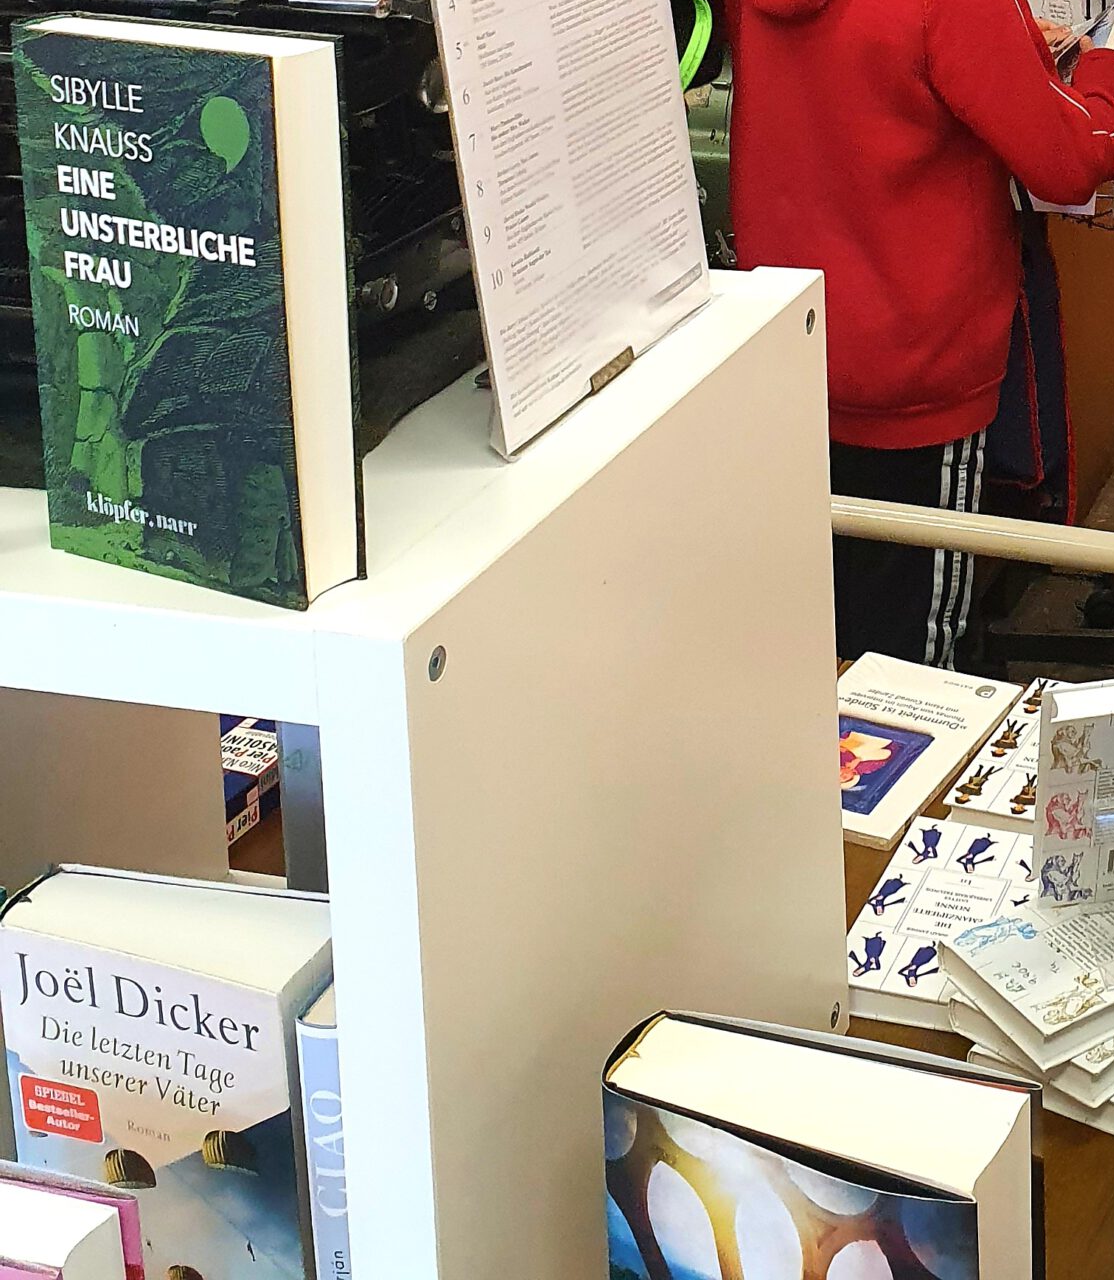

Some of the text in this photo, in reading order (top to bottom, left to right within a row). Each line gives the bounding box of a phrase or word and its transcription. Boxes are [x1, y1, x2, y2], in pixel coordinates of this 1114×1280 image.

[455, 42, 463, 60] 5
[50, 74, 145, 114] SIBYLLE
[462, 88, 470, 106] 6
[54, 122, 154, 163] KNAUSS
[469, 133, 477, 152] 7
[57, 165, 117, 200] EINE
[476, 179, 484, 198] 8
[60, 208, 257, 268] UNSTERBLICHE
[484, 225, 492, 244] 9
[64, 251, 132, 289] FRAU
[491, 269, 504, 290] 10
[68, 304, 140, 337] ROMAN
[867, 688, 960, 715] mit Hans Conrad Zander
[881, 703, 896, 717] ist
[895, 700, 919, 713] Aquin
[897, 708, 968, 731] »Dummheit
[936, 709, 966, 724] Thomas
[247, 750, 277, 765] Pier
[237, 805, 259, 832] Pier
[935, 901, 972, 913] NONNE
[937, 920, 952, 930] DIE
[14, 951, 260, 1052] Joël Dicker
[41, 1015, 236, 1094] Die letzten Tage
[34, 1084, 86, 1108] SPIEGEL
[60, 1058, 222, 1116] unserer Väter
[28, 1099, 96, 1122] Bestseller-
[46, 1114, 82, 1132] Autor
[127, 1120, 172, 1143] Roman
[309, 1089, 349, 1218] CIAO
